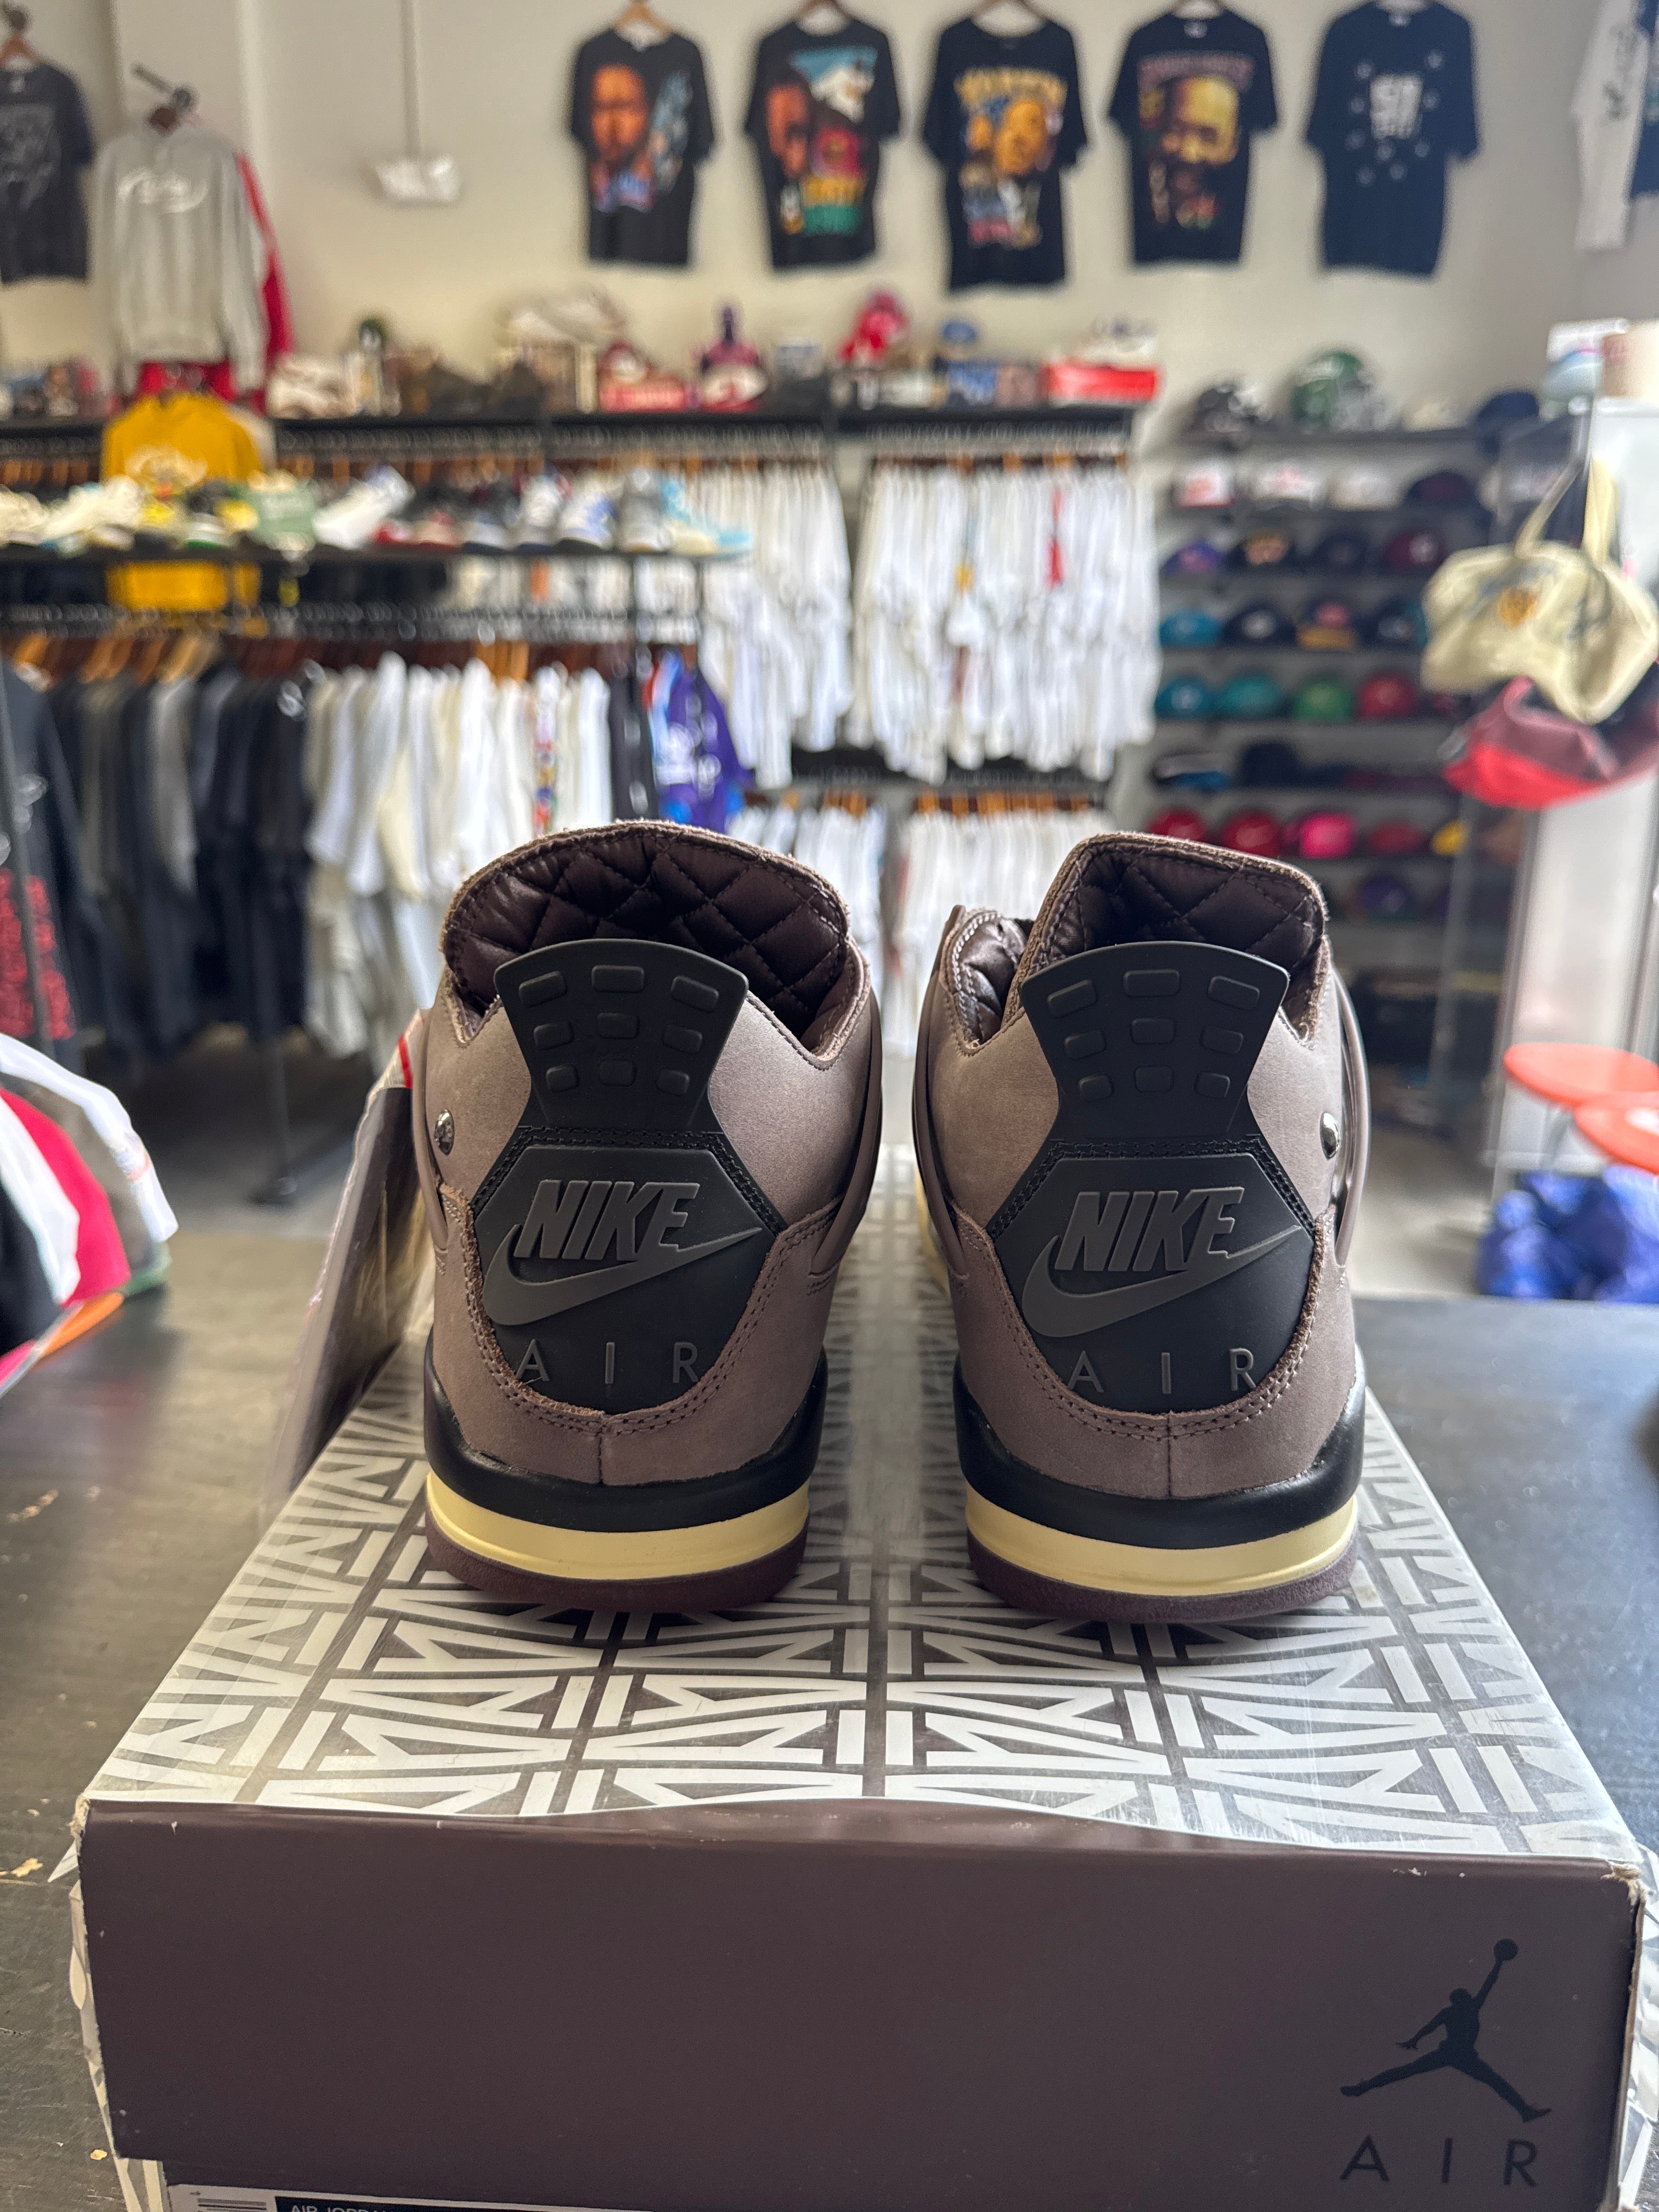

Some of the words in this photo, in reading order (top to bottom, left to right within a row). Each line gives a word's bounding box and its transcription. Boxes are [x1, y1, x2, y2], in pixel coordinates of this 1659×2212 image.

[514, 1180, 701, 1261] NIKE
[1054, 1186, 1245, 1272] NIKE
[516, 1339, 698, 1385] AIR
[1067, 1347, 1257, 1394] AIR
[1340, 2135, 1538, 2187] AIR
